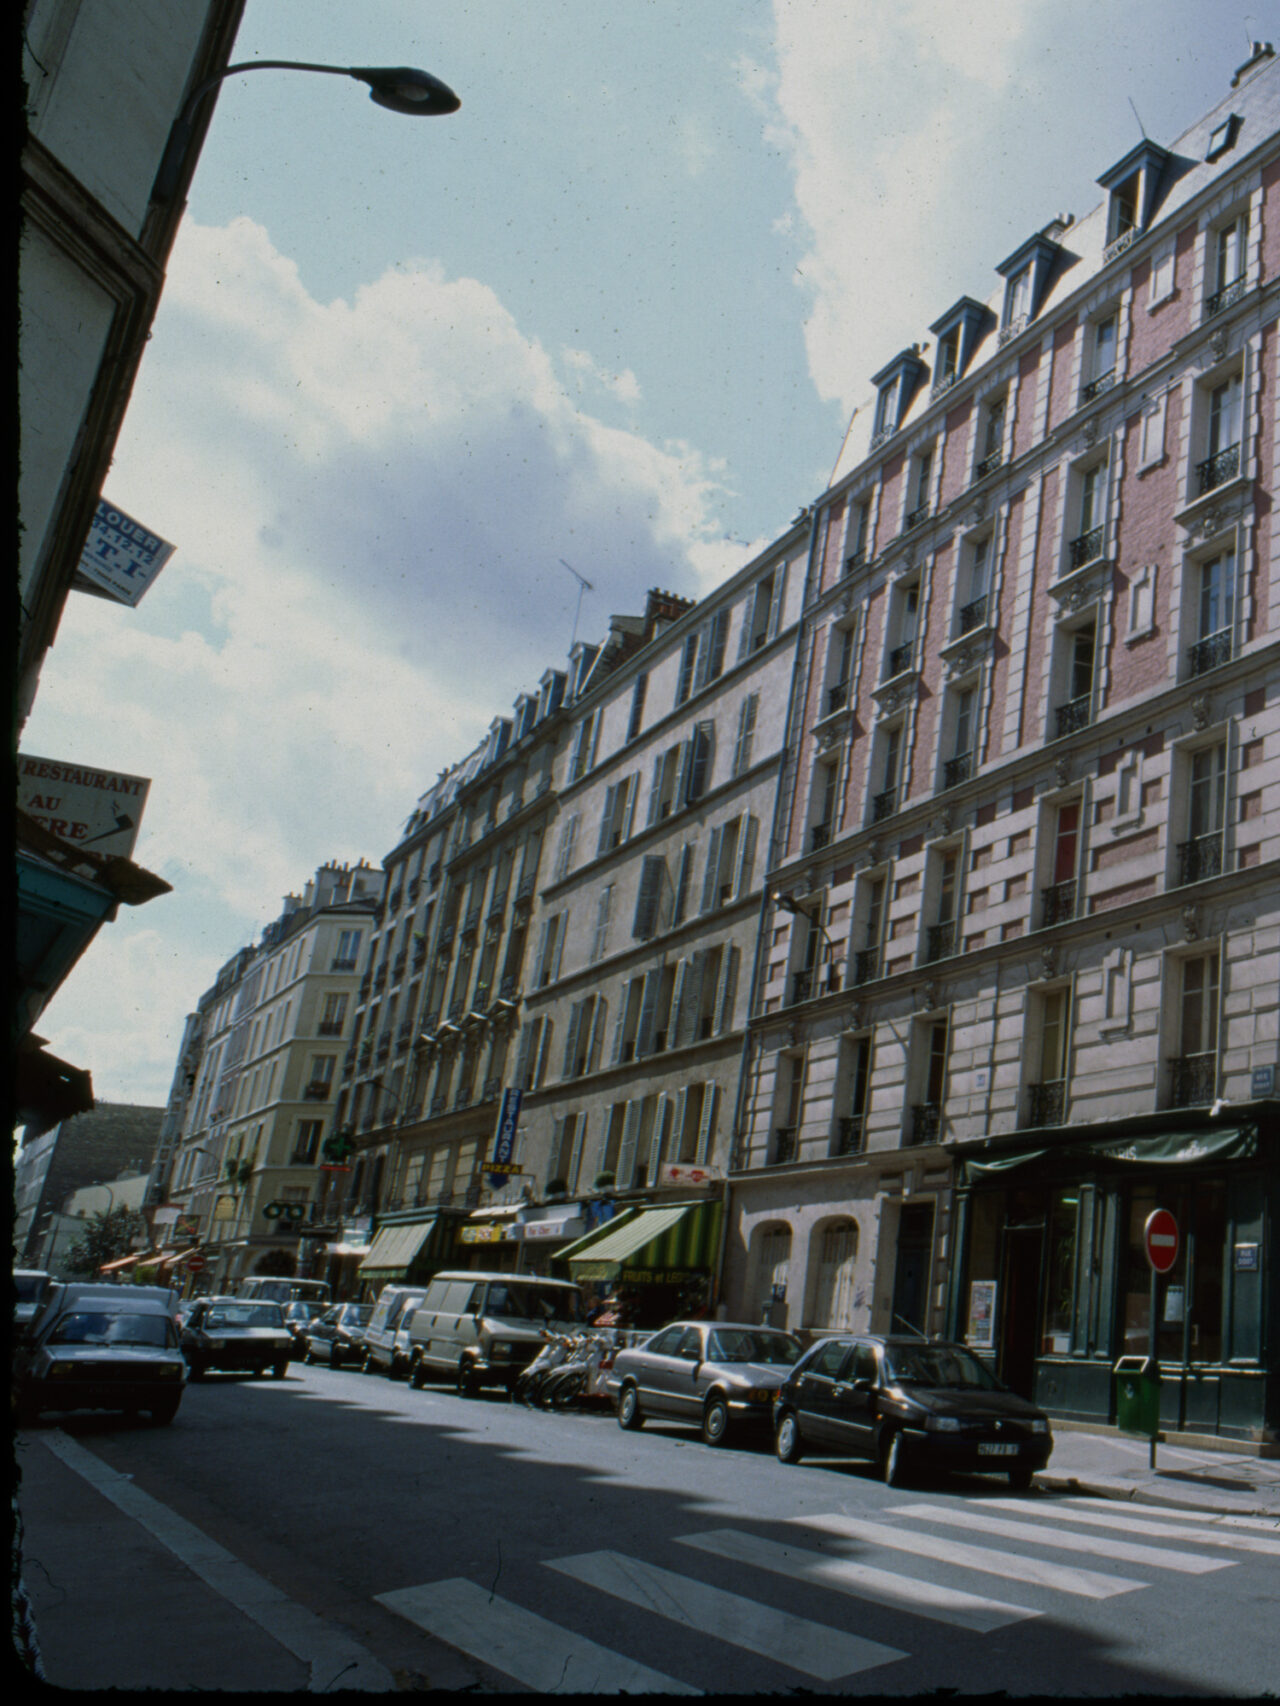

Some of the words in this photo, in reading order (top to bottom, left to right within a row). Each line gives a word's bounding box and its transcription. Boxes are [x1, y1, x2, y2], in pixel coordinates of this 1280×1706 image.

[96, 503, 158, 552] LOUER
[22, 760, 144, 796] RESTAURANT
[27, 794, 62, 811] AU
[30, 814, 89, 839] ERE
[499, 1089, 520, 1164] RESTAURANT
[481, 1164, 520, 1174] PIZZA
[623, 1270, 652, 1283] FRUITS
